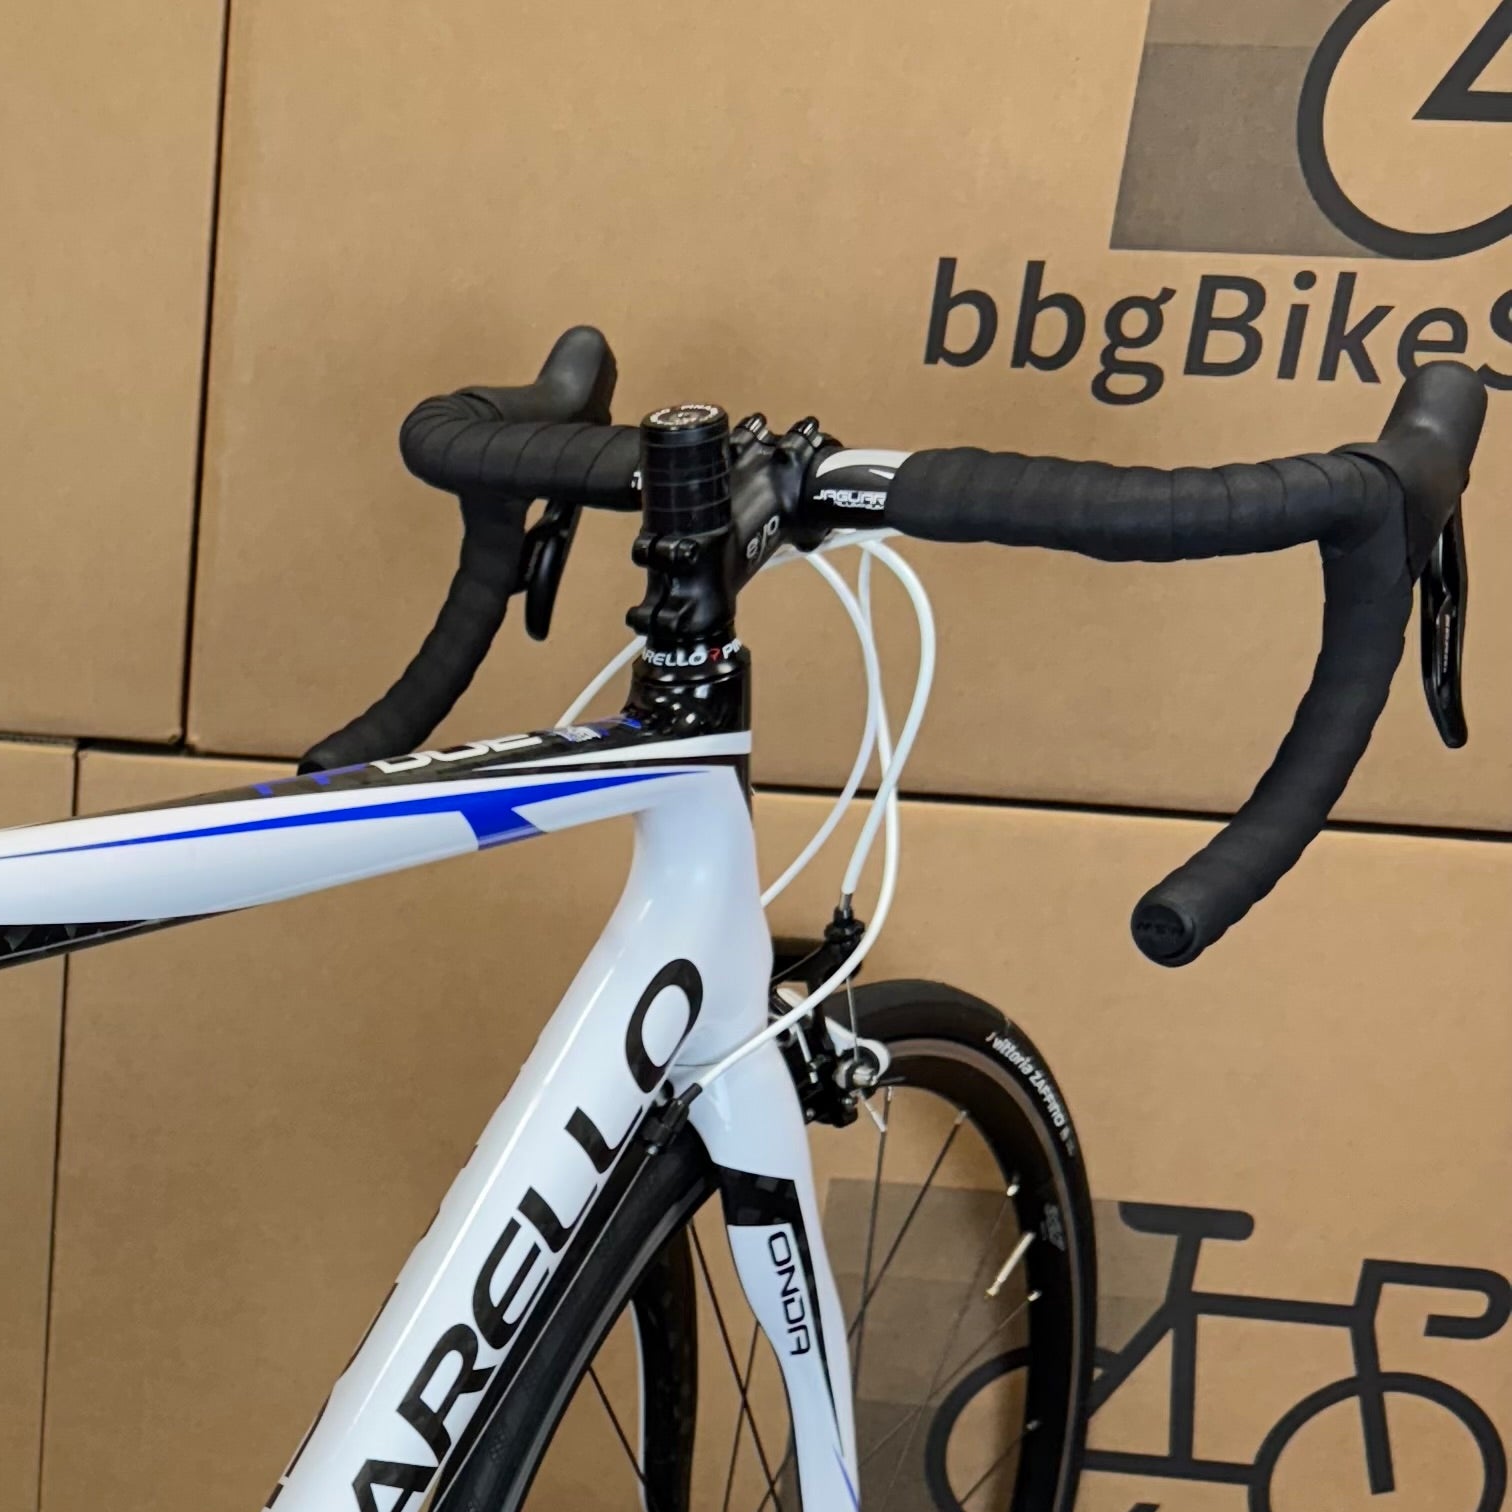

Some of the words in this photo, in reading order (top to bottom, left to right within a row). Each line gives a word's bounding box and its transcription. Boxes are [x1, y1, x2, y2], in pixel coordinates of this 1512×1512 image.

[924, 257, 1512, 405] bbgBike
[992, 1037, 1034, 1076] vittoria
[767, 1231, 811, 1356] ONDA
